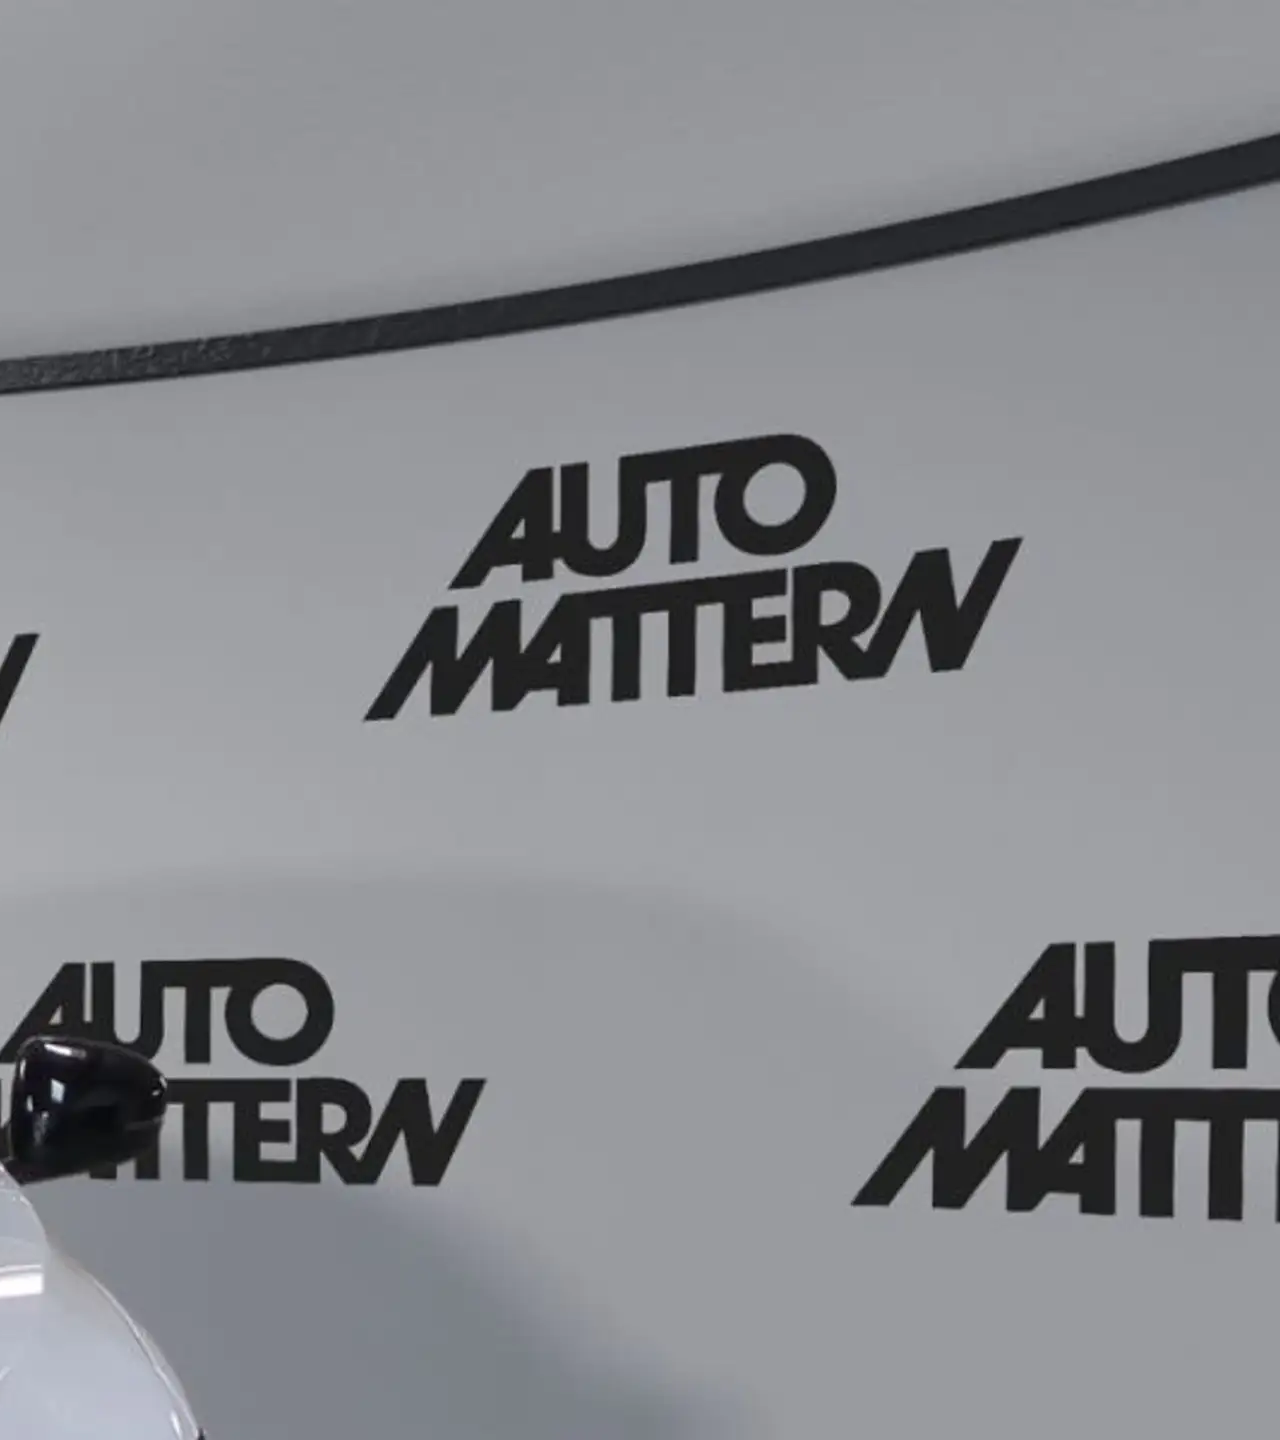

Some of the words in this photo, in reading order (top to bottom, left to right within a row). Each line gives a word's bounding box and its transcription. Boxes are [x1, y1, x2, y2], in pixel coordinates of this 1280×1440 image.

[448, 434, 837, 590] AUTO
[364, 537, 1023, 721] MATTERN
[954, 934, 1280, 1074] AUT
[851, 1087, 1280, 1223] MATT
